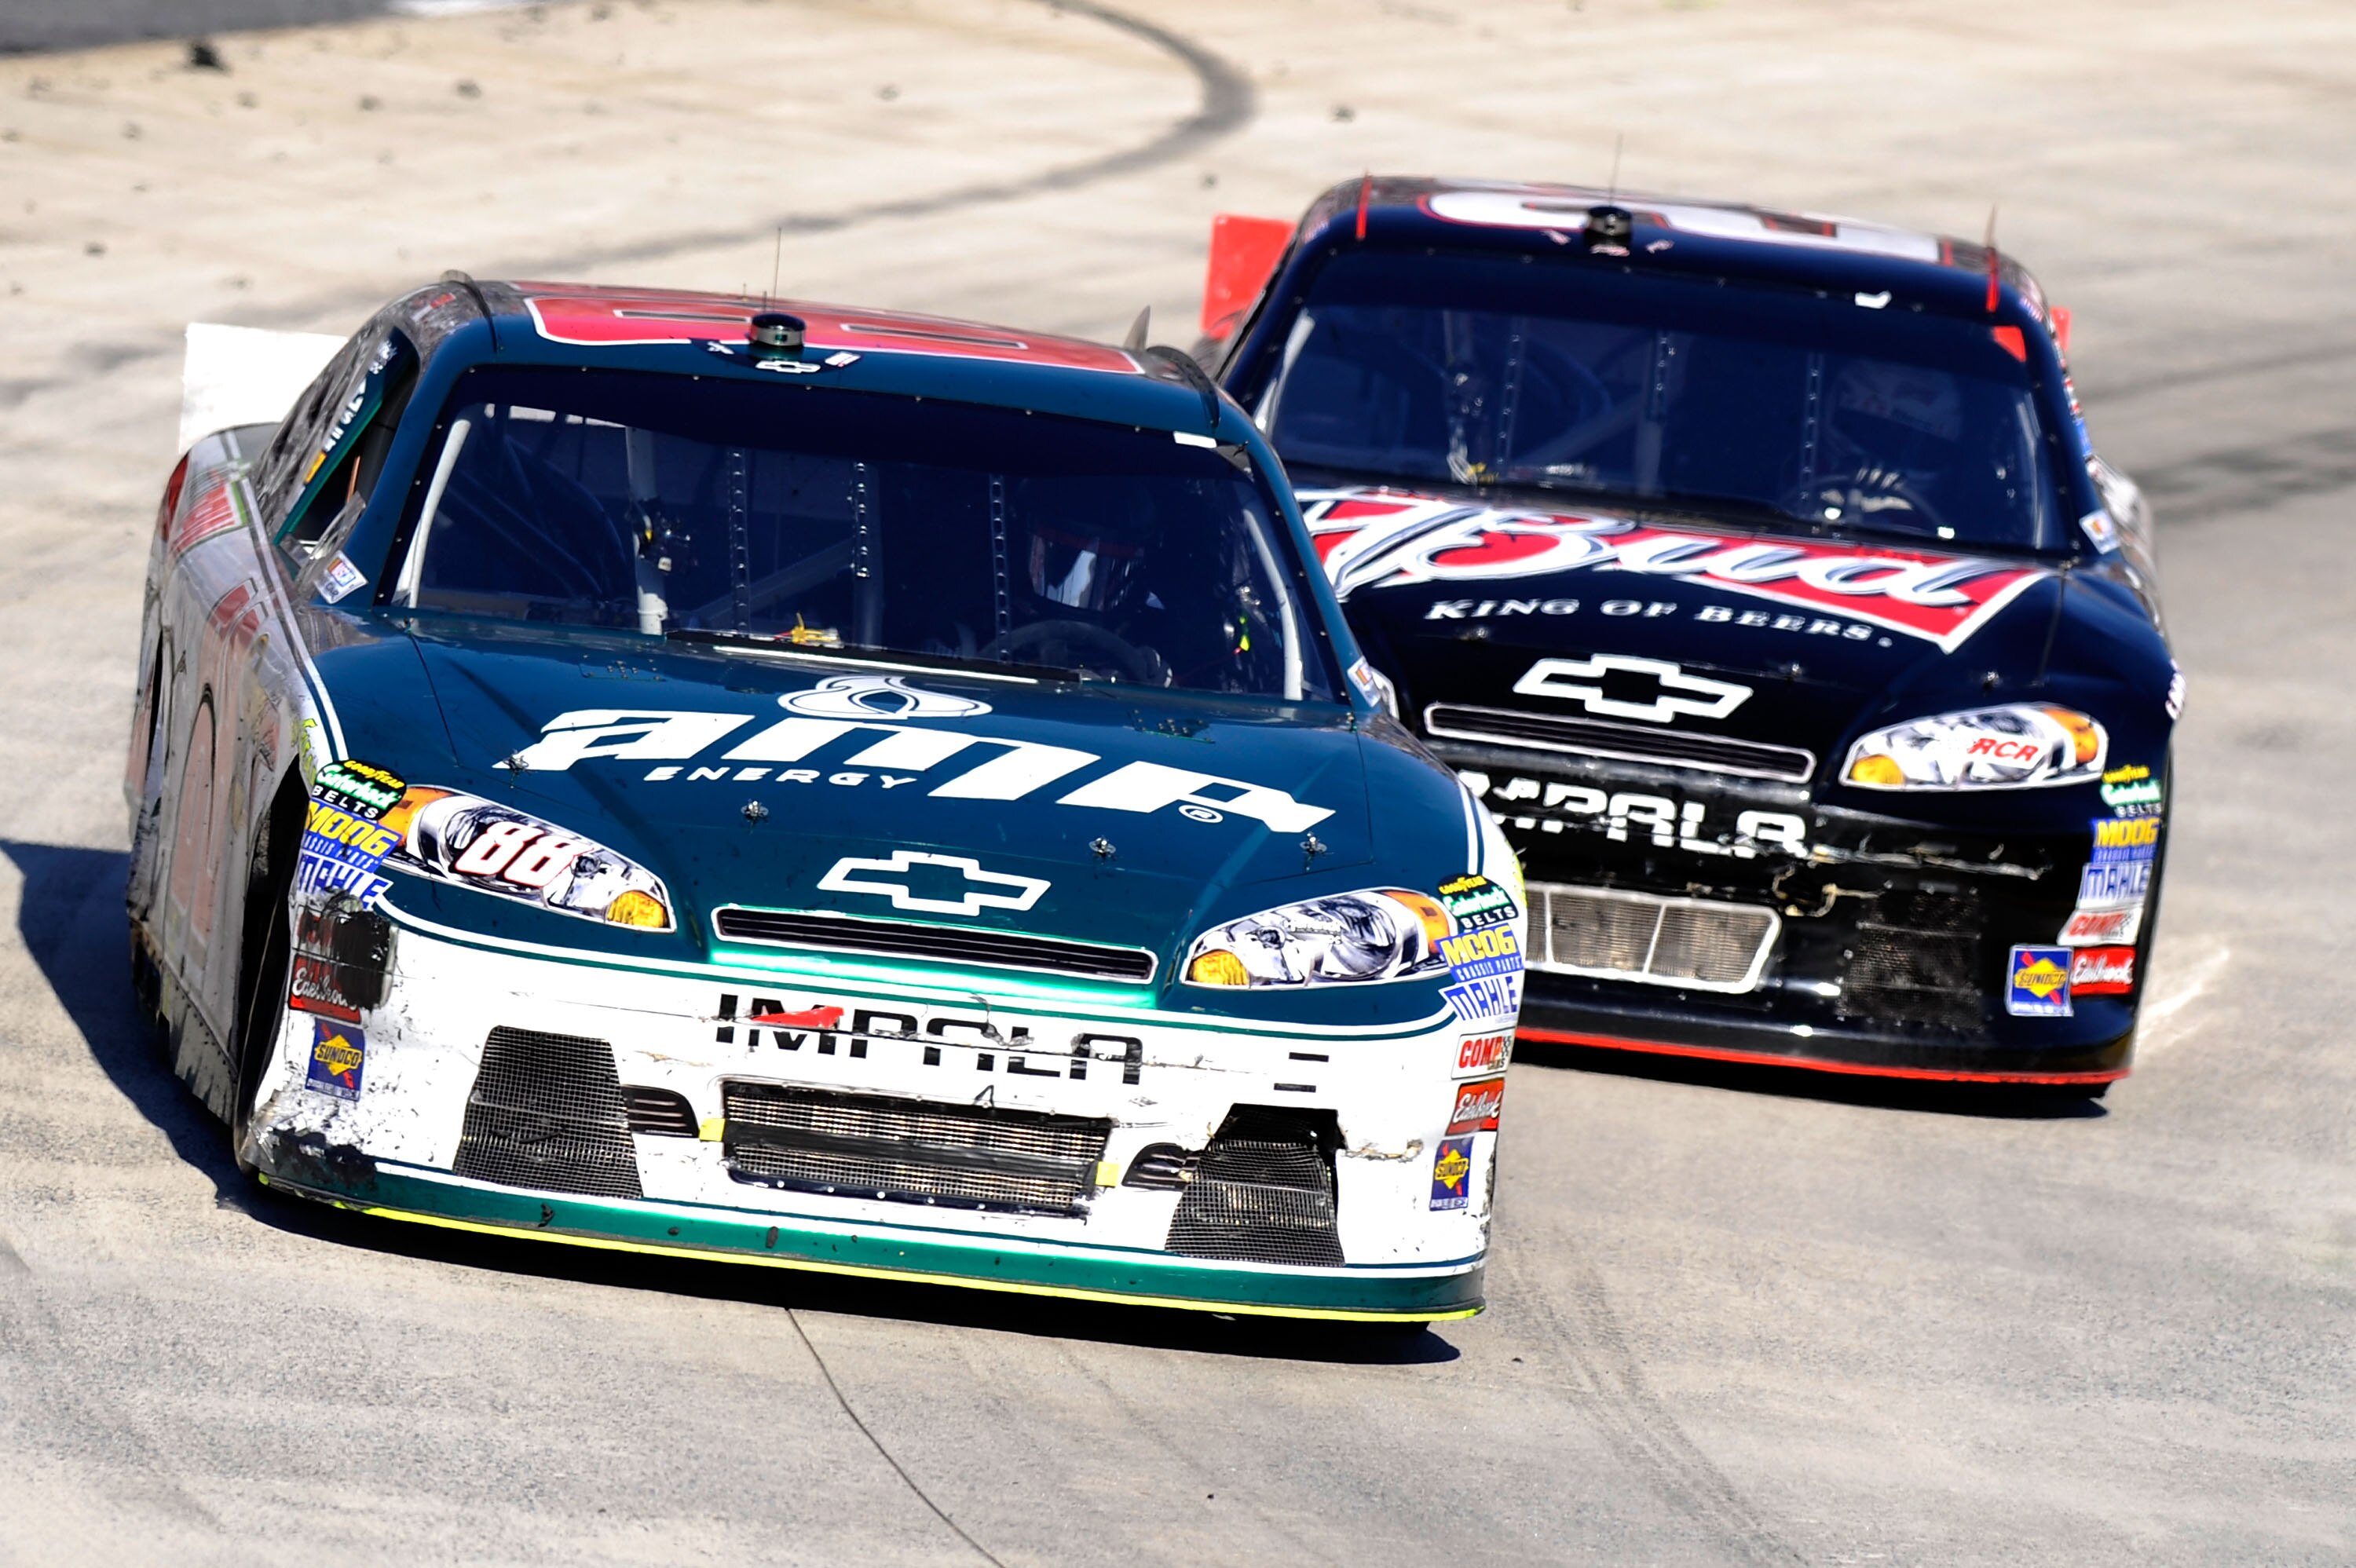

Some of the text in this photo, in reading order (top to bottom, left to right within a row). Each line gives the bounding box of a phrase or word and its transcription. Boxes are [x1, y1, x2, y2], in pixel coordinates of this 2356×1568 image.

[1319, 506, 1999, 606] Bud
[1425, 598, 1581, 622] KING
[1600, 600, 1678, 619] OF
[1967, 738, 2039, 762] RCR
[644, 766, 917, 788] ENERGY
[312, 785, 379, 818] BELTS
[1458, 769, 1809, 859] MPALA
[2114, 802, 2161, 818] BELTS
[305, 802, 399, 857] MOOG
[2098, 817, 2160, 847] MOOG
[455, 821, 594, 888] 88
[2080, 864, 2149, 900] MAHLE
[1460, 906, 1516, 928] BELTS
[1440, 925, 1517, 967] MOOG
[1443, 976, 1518, 1021] MAHLE
[317, 1044, 360, 1066] SUNOCO
[714, 992, 1143, 1086] IMPALA
[1458, 1036, 1503, 1069] COMP
